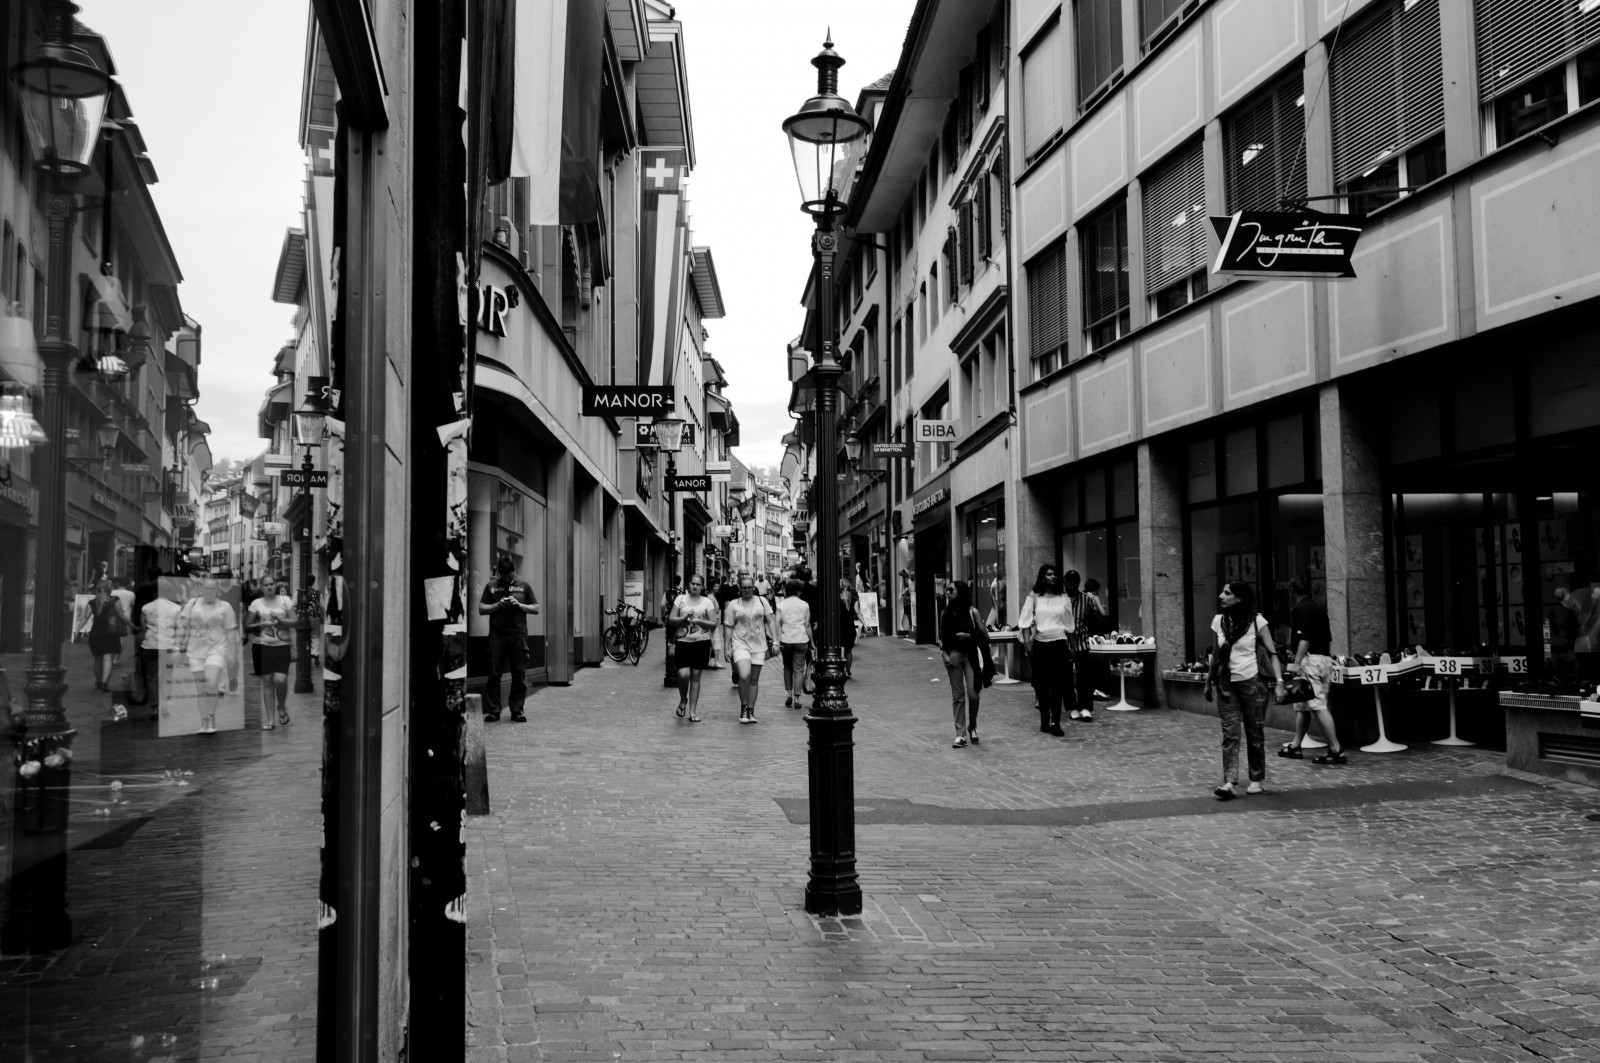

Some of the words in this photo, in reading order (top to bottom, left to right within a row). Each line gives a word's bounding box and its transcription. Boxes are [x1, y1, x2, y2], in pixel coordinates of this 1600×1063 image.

[594, 393, 663, 408] MANOR
[922, 424, 956, 437] BiBA
[1439, 659, 1457, 673] 38
[1365, 668, 1382, 683] 37
